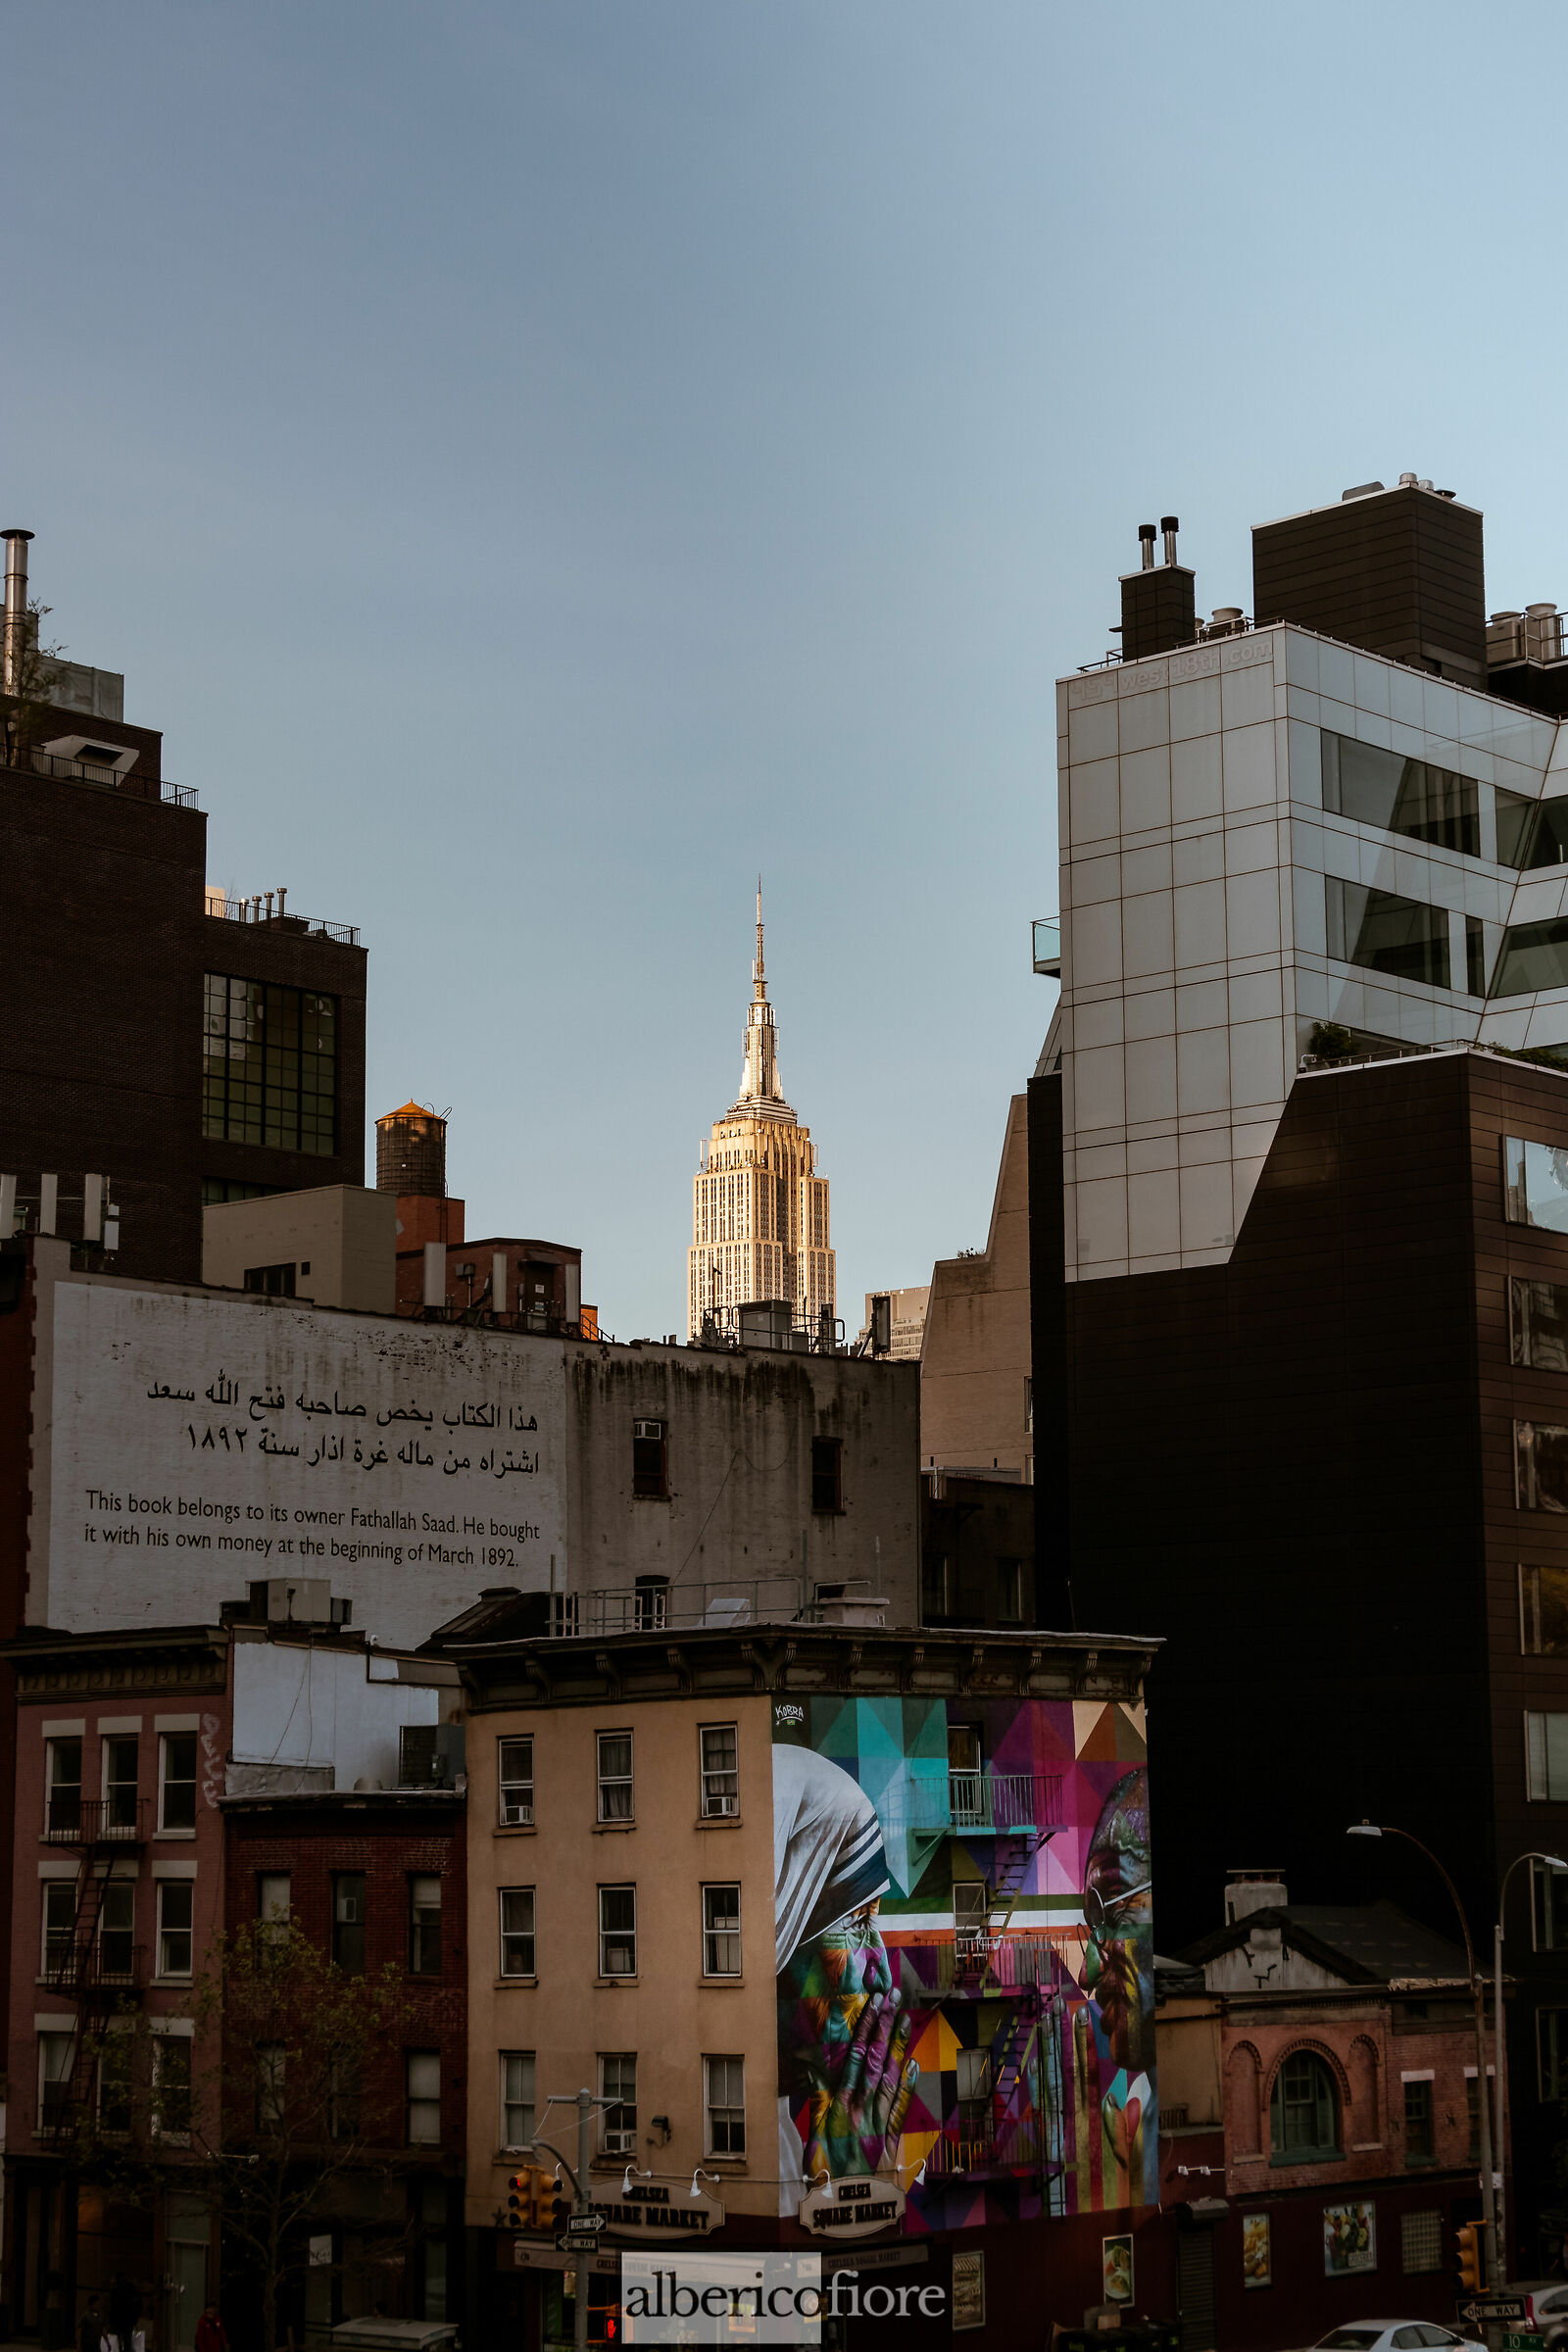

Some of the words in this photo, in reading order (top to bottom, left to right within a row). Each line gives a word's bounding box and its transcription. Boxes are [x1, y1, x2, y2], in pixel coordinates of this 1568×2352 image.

[147, 1381, 195, 1401] سعد
[249, 1386, 285, 1421] فتح
[295, 1391, 367, 1421] صاحبه
[376, 1399, 433, 1432] يخص
[442, 1401, 501, 1435] الكتاب
[509, 1405, 538, 1432] هذا
[188, 1424, 248, 1452] ١٨٩٢
[258, 1427, 300, 1457] سنة
[307, 1435, 346, 1467] اذار
[353, 1439, 389, 1471] غرة
[397, 1440, 434, 1466] ماله
[443, 1449, 470, 1475] من
[479, 1448, 539, 1479] اشتراه
[85, 1490, 122, 1511] This
[128, 1494, 172, 1514] book
[178, 1496, 240, 1524] belongs
[247, 1504, 264, 1519] to
[270, 1503, 288, 1522] its
[294, 1508, 345, 1526] owner
[351, 1507, 416, 1531] Fathallah
[422, 1512, 459, 1534] Saad.
[464, 1516, 485, 1536] He
[490, 1518, 540, 1544] bought
[84, 1523, 96, 1543] it
[103, 1525, 139, 1545] with
[147, 1526, 169, 1546] his
[175, 1533, 211, 1548] own
[218, 1535, 272, 1558] money
[278, 1538, 294, 1553] at
[299, 1536, 324, 1556] the
[330, 1538, 403, 1565] beginning
[408, 1543, 424, 1561] of
[428, 1544, 474, 1565] March
[481, 1546, 518, 1568] 1892.
[775, 1704, 804, 1719] KOBRA
[839, 2183, 871, 2201] CHELSEA
[646, 2207, 709, 2230] MARKET
[813, 2206, 853, 2230] SQUARE
[855, 2201, 898, 2224] MARKET
[1467, 2307, 1487, 2317] ONE
[1495, 2305, 1515, 2316] WAY
[1509, 2335, 1521, 2348] 10
